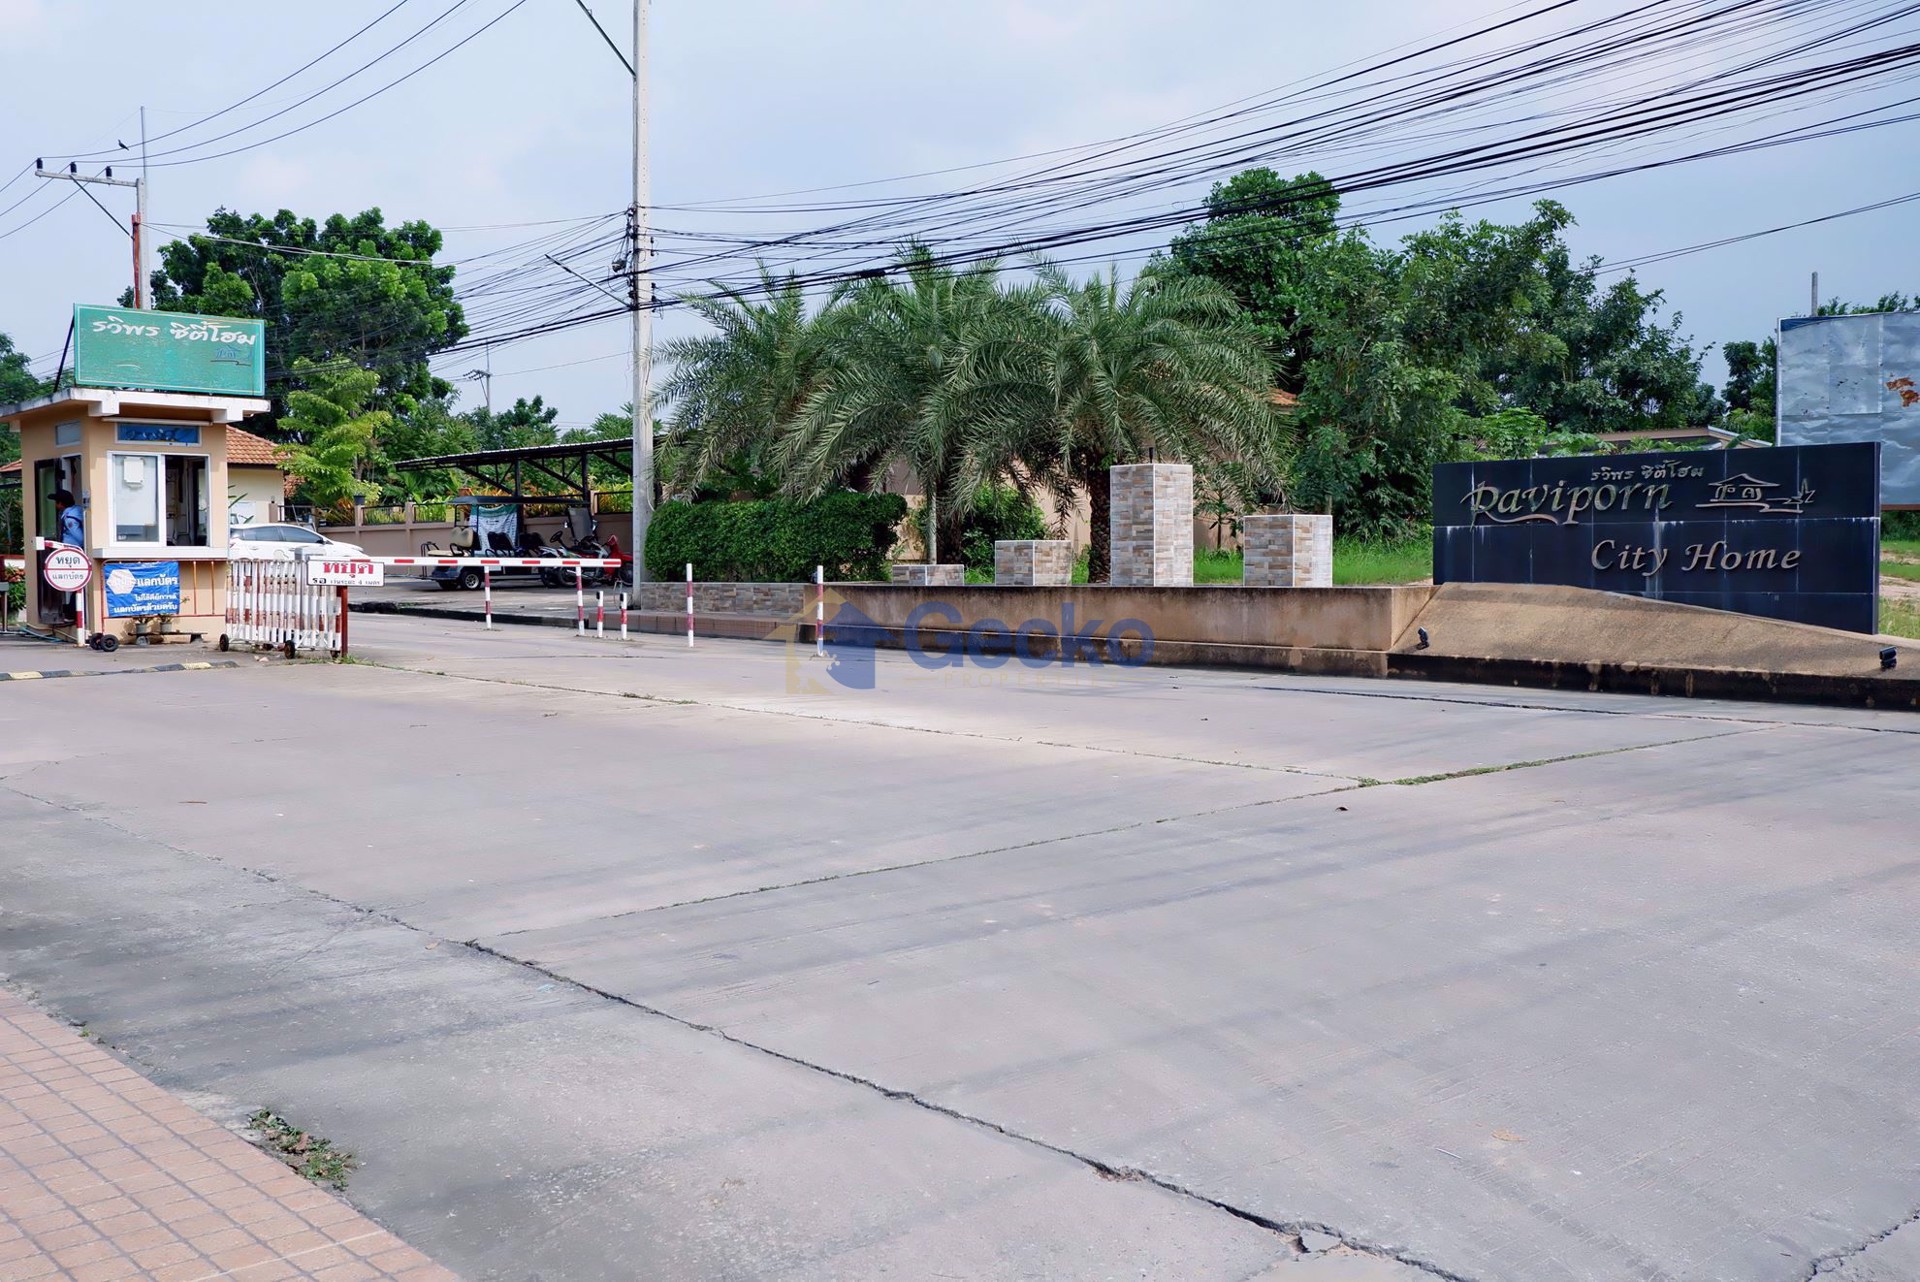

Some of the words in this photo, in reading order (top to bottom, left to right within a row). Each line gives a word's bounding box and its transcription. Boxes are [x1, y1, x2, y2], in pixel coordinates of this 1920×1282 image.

[1459, 480, 1673, 532] Raviporn
[55, 556, 81, 568] หยุด
[1590, 539, 1669, 577] City
[1681, 541, 1802, 573] Home
[52, 571, 84, 580] แลกบัตร
[323, 562, 374, 578] หยุด
[137, 574, 178, 587] แลกบัตร
